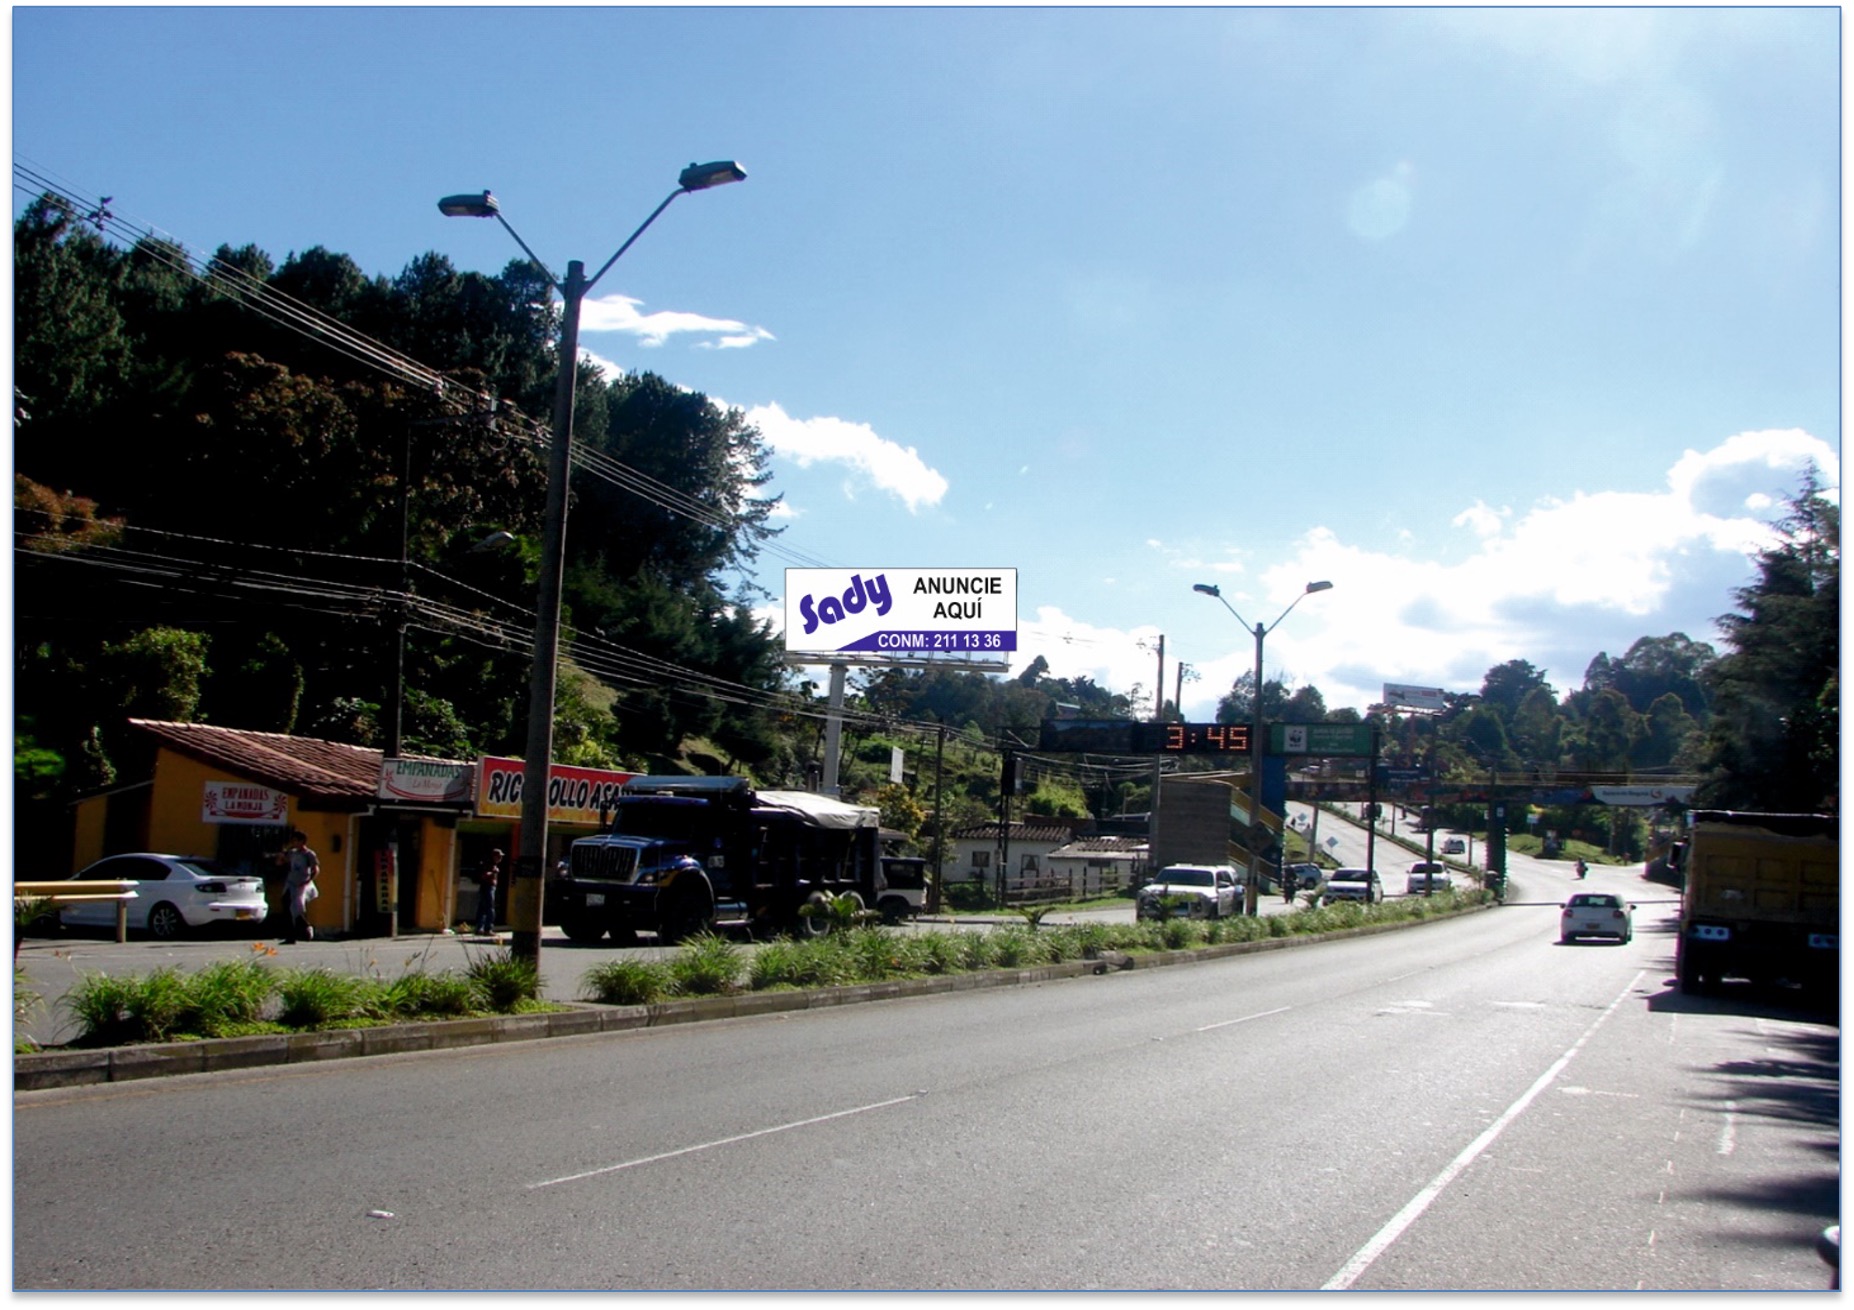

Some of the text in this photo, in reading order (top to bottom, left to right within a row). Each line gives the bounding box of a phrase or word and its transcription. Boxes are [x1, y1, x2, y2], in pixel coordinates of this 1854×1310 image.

[913, 577, 1002, 594] ANUNCIE
[799, 573, 893, 635] Sady
[933, 597, 982, 619] AQUÍ
[878, 633, 1001, 648] CONM: 211 13 36
[1165, 726, 1247, 750] 3:45
[396, 761, 461, 778] EMPANADAS
[223, 788, 269, 800] EMPANADAS
[487, 769, 525, 805] RIC
[548, 776, 590, 810] OLLO
[225, 801, 236, 810] LA
